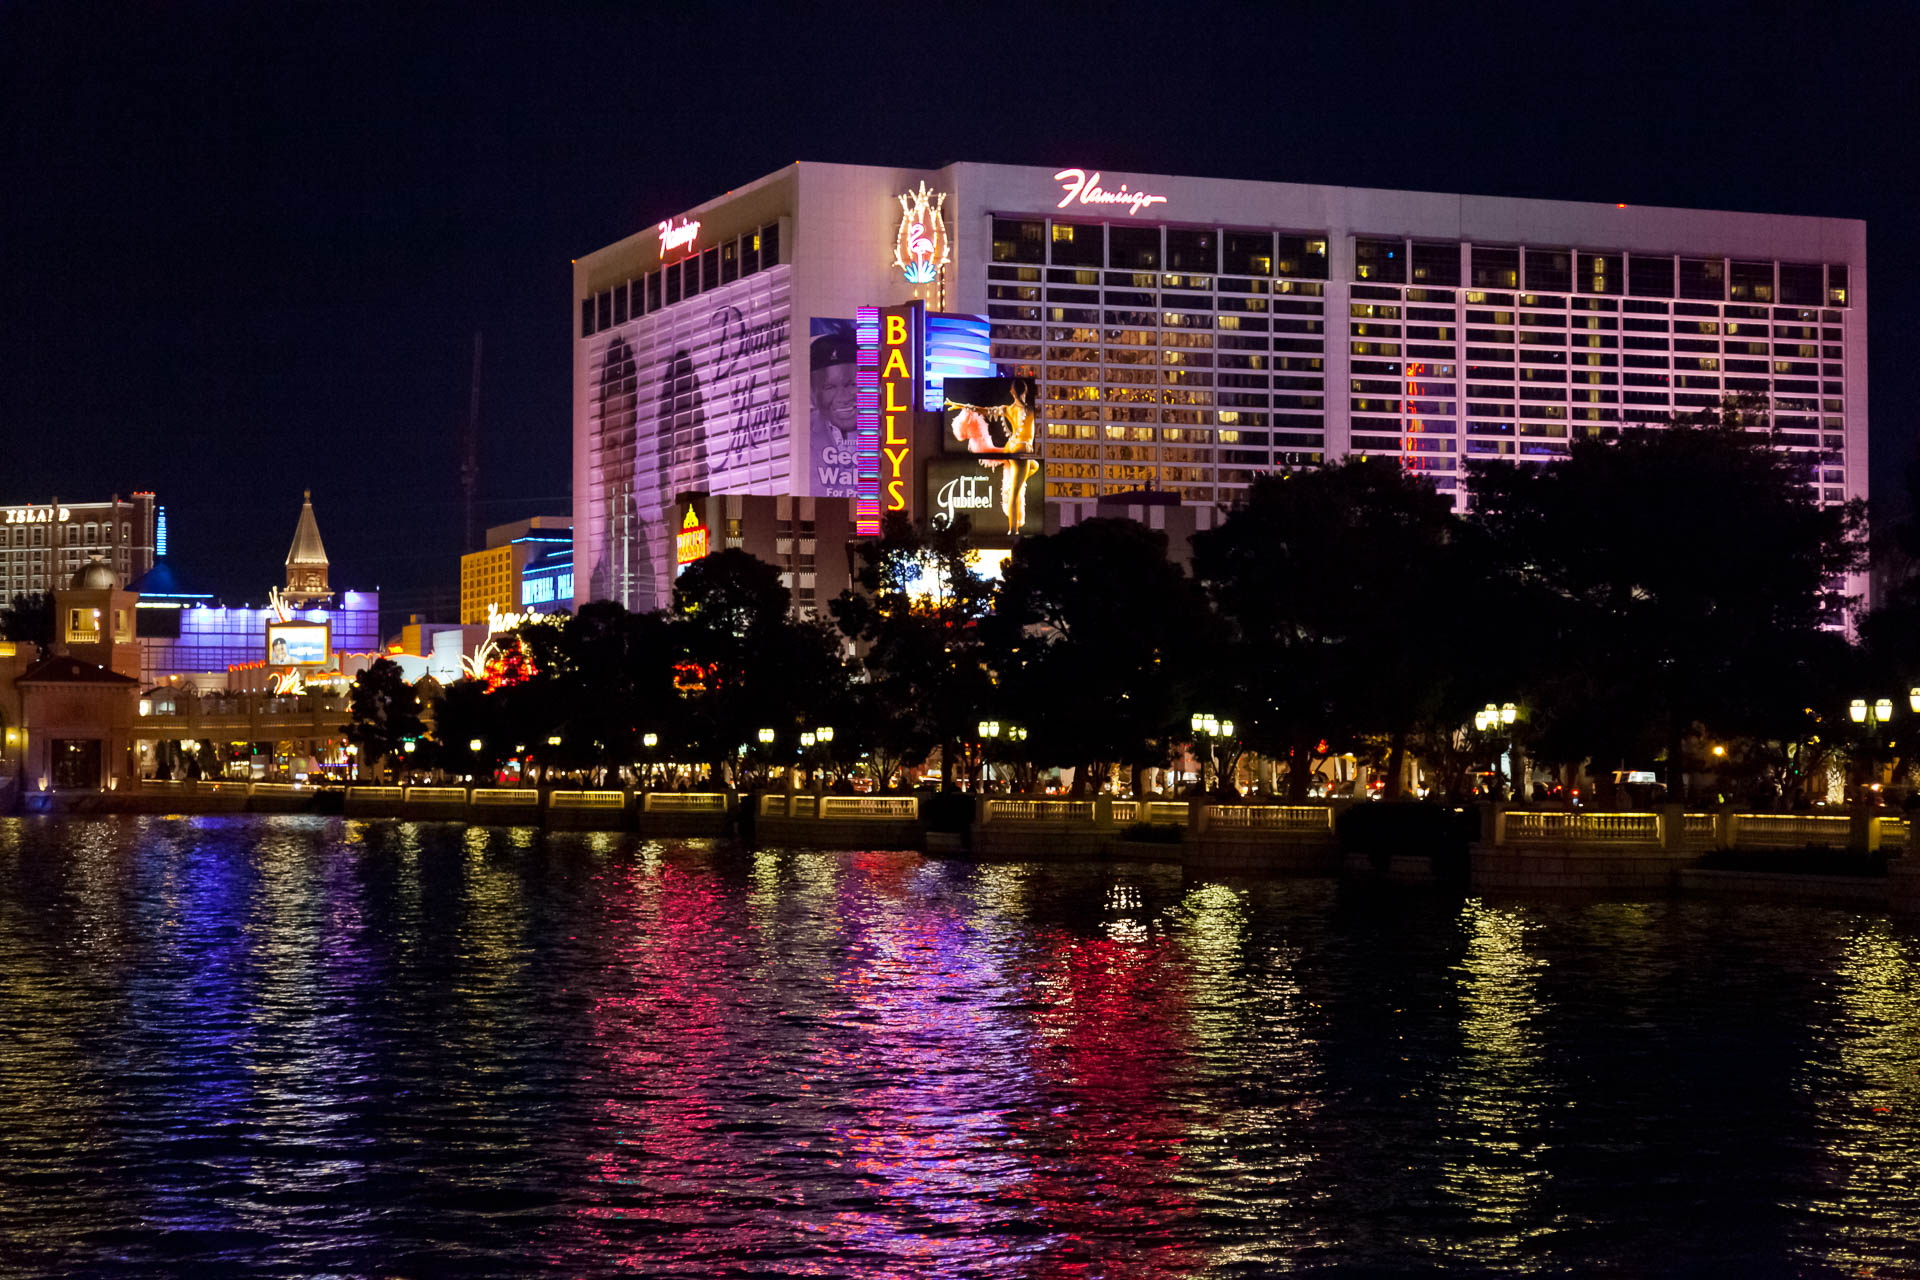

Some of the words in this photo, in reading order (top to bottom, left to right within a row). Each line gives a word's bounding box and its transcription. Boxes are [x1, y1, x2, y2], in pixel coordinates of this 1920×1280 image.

[1053, 168, 1168, 216] Flamingo
[658, 217, 702, 260] Flamingo
[882, 315, 910, 511] BALLYS
[826, 488, 843, 497] For
[931, 478, 993, 532] Jubilee!
